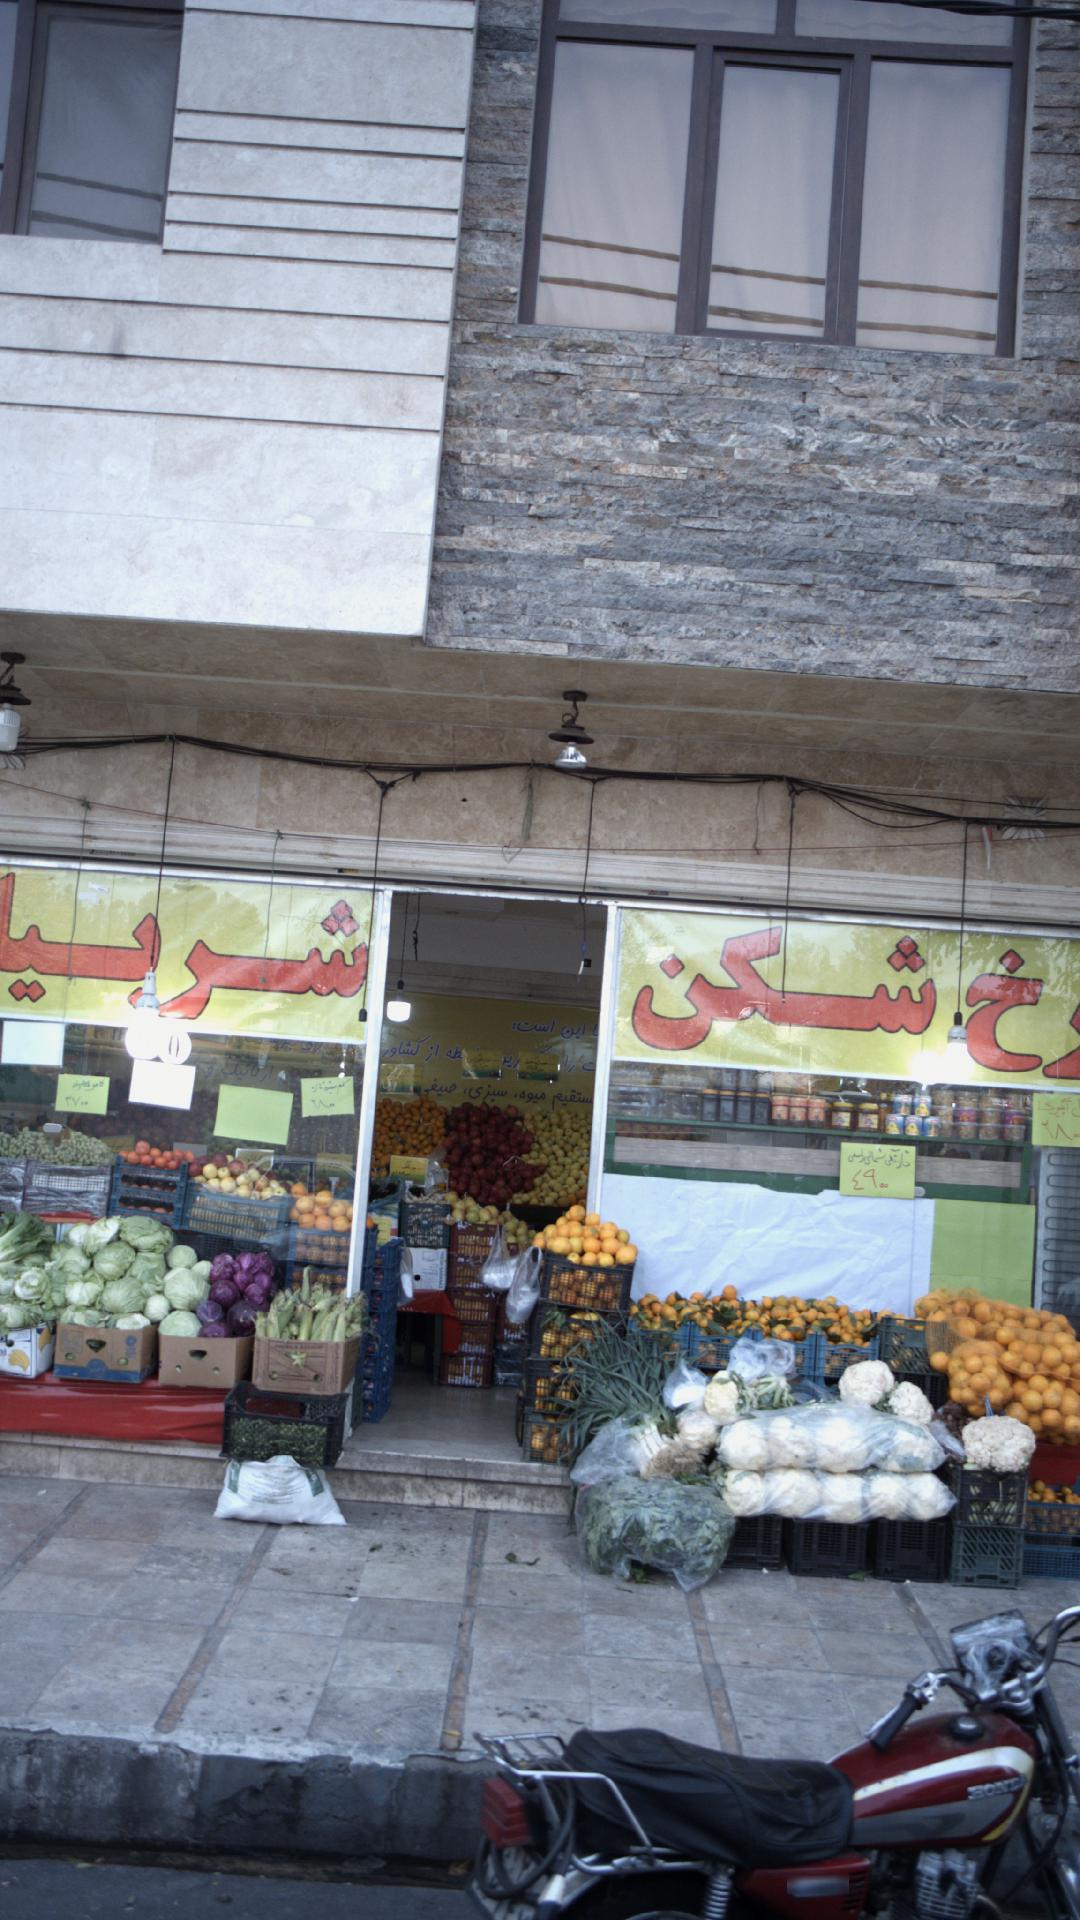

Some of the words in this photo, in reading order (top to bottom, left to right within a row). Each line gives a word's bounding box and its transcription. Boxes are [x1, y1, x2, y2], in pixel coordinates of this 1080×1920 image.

[632, 926, 936, 1051] شکن
[965, 948, 1080, 1080] رخ
[424, 1044, 440, 1063] از
